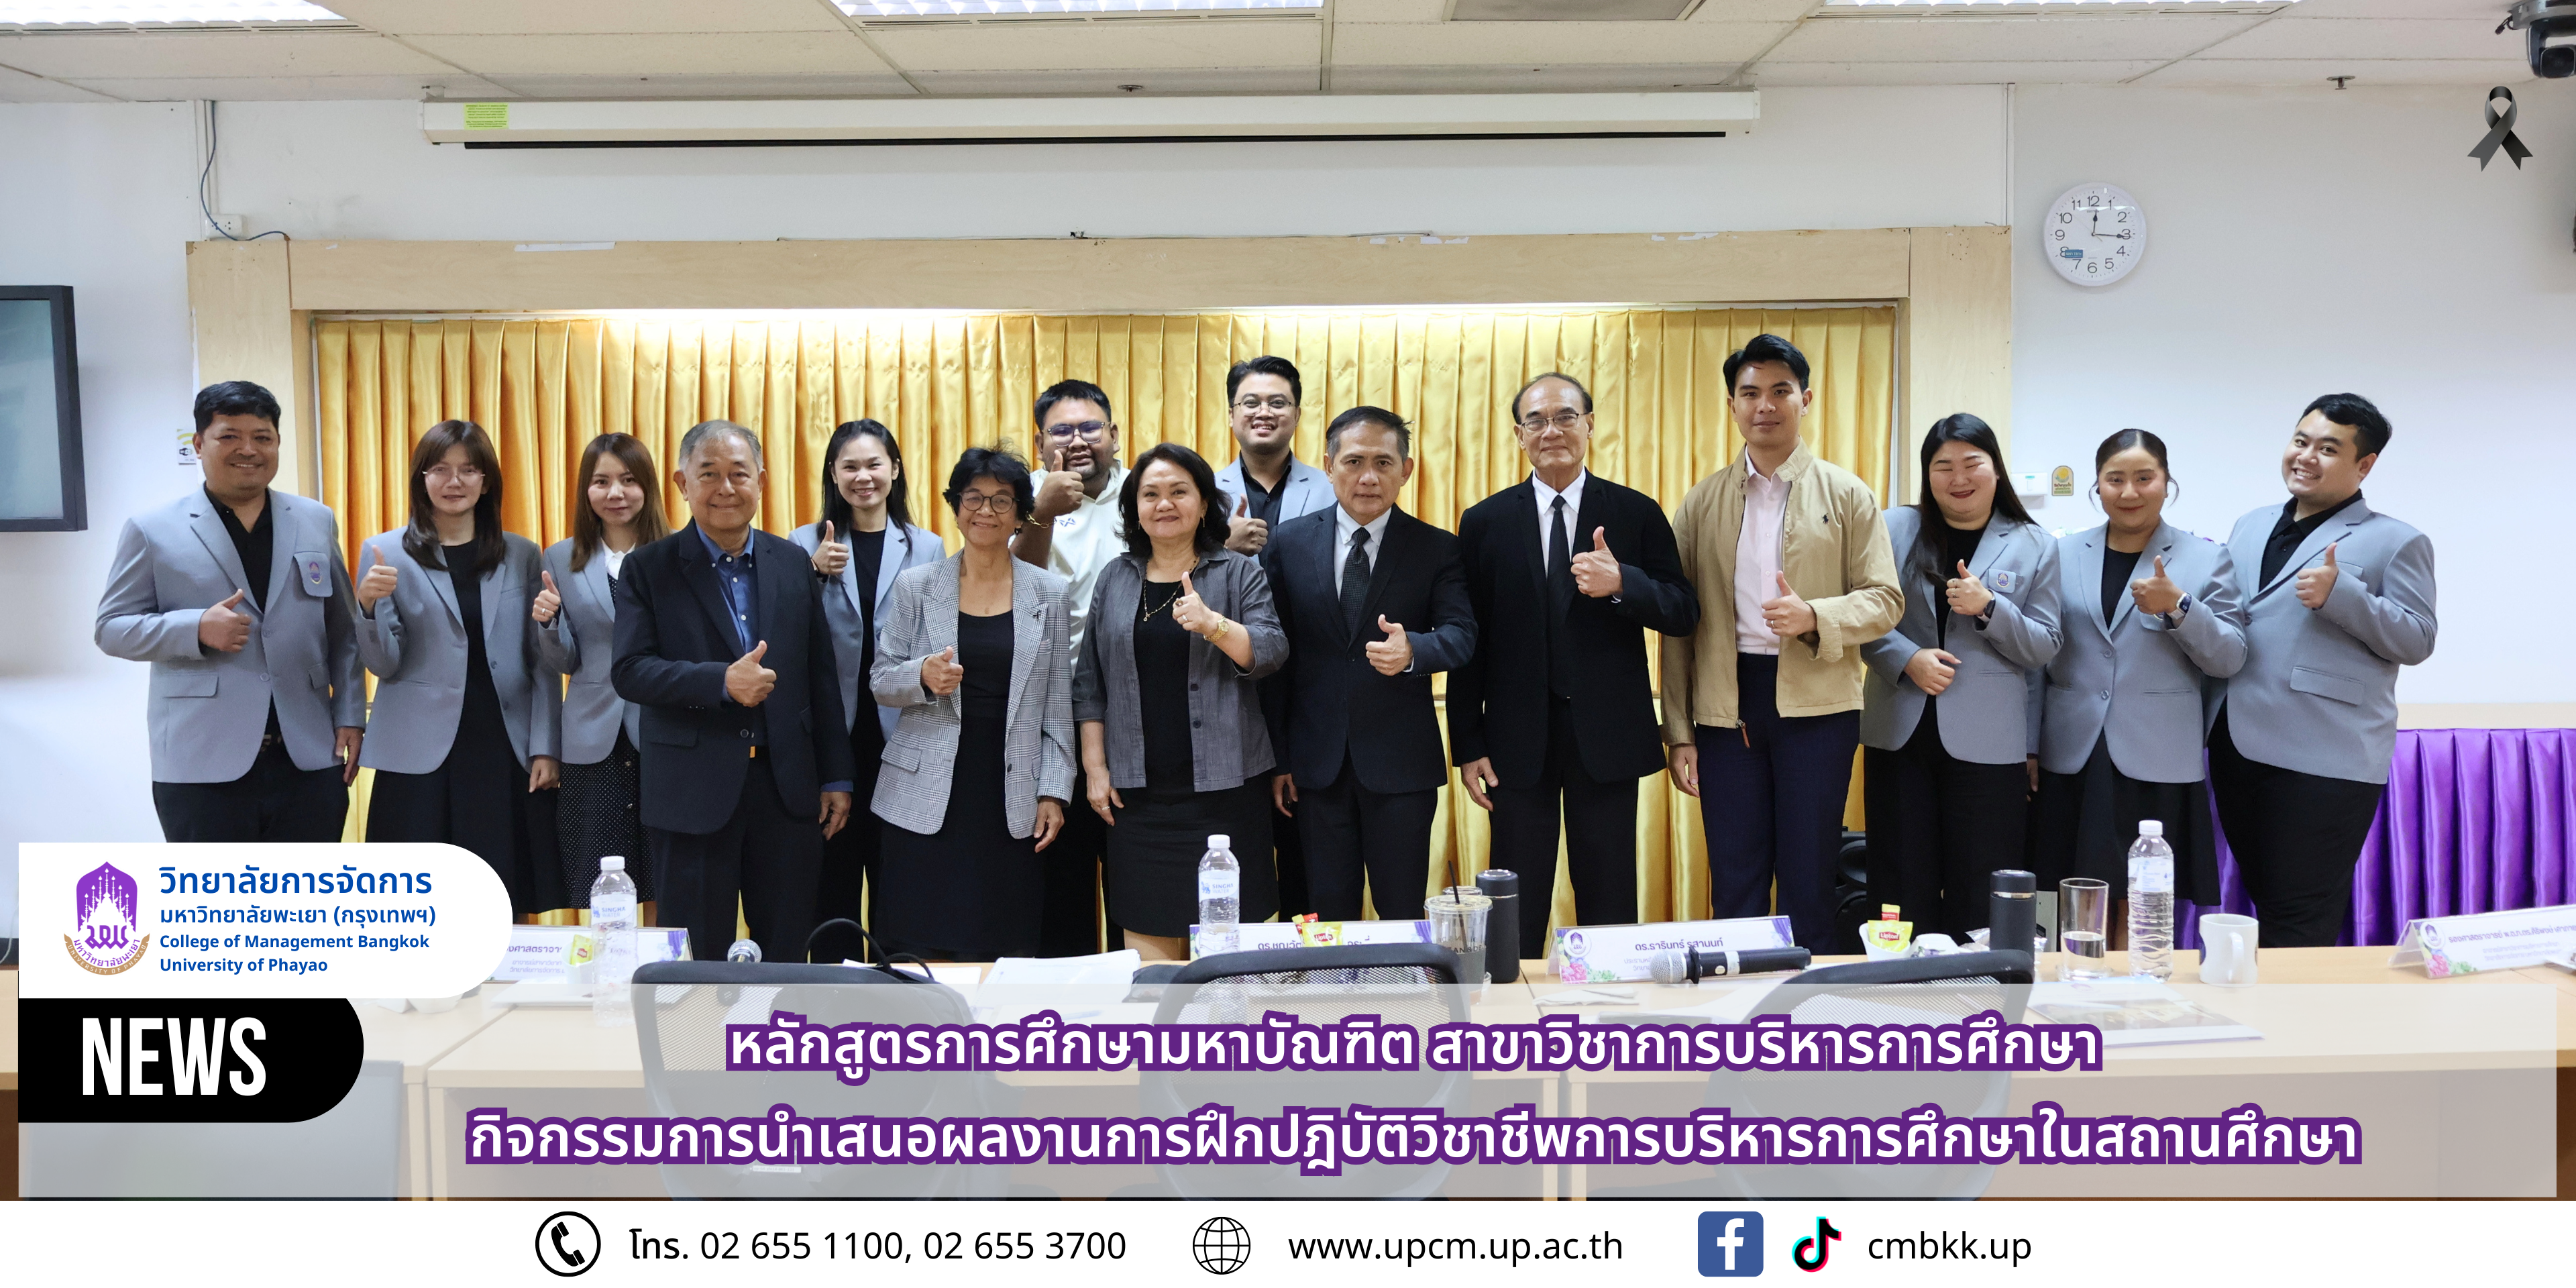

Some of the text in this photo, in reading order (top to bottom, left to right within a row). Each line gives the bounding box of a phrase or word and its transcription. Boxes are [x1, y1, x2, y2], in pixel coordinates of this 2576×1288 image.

[2072, 199, 2081, 210] 11
[2087, 195, 2100, 207] 12
[2108, 199, 2112, 210] 1
[2059, 212, 2073, 223] 10
[2117, 211, 2127, 223] 2
[2055, 229, 2065, 241] 9
[2121, 229, 2131, 240] 3
[2116, 246, 2126, 257] 4
[2072, 258, 2082, 270] 7
[2087, 262, 2098, 274] 6
[2104, 258, 2114, 270] 5
[507, 945, 562, 953] งศาสตราจา
